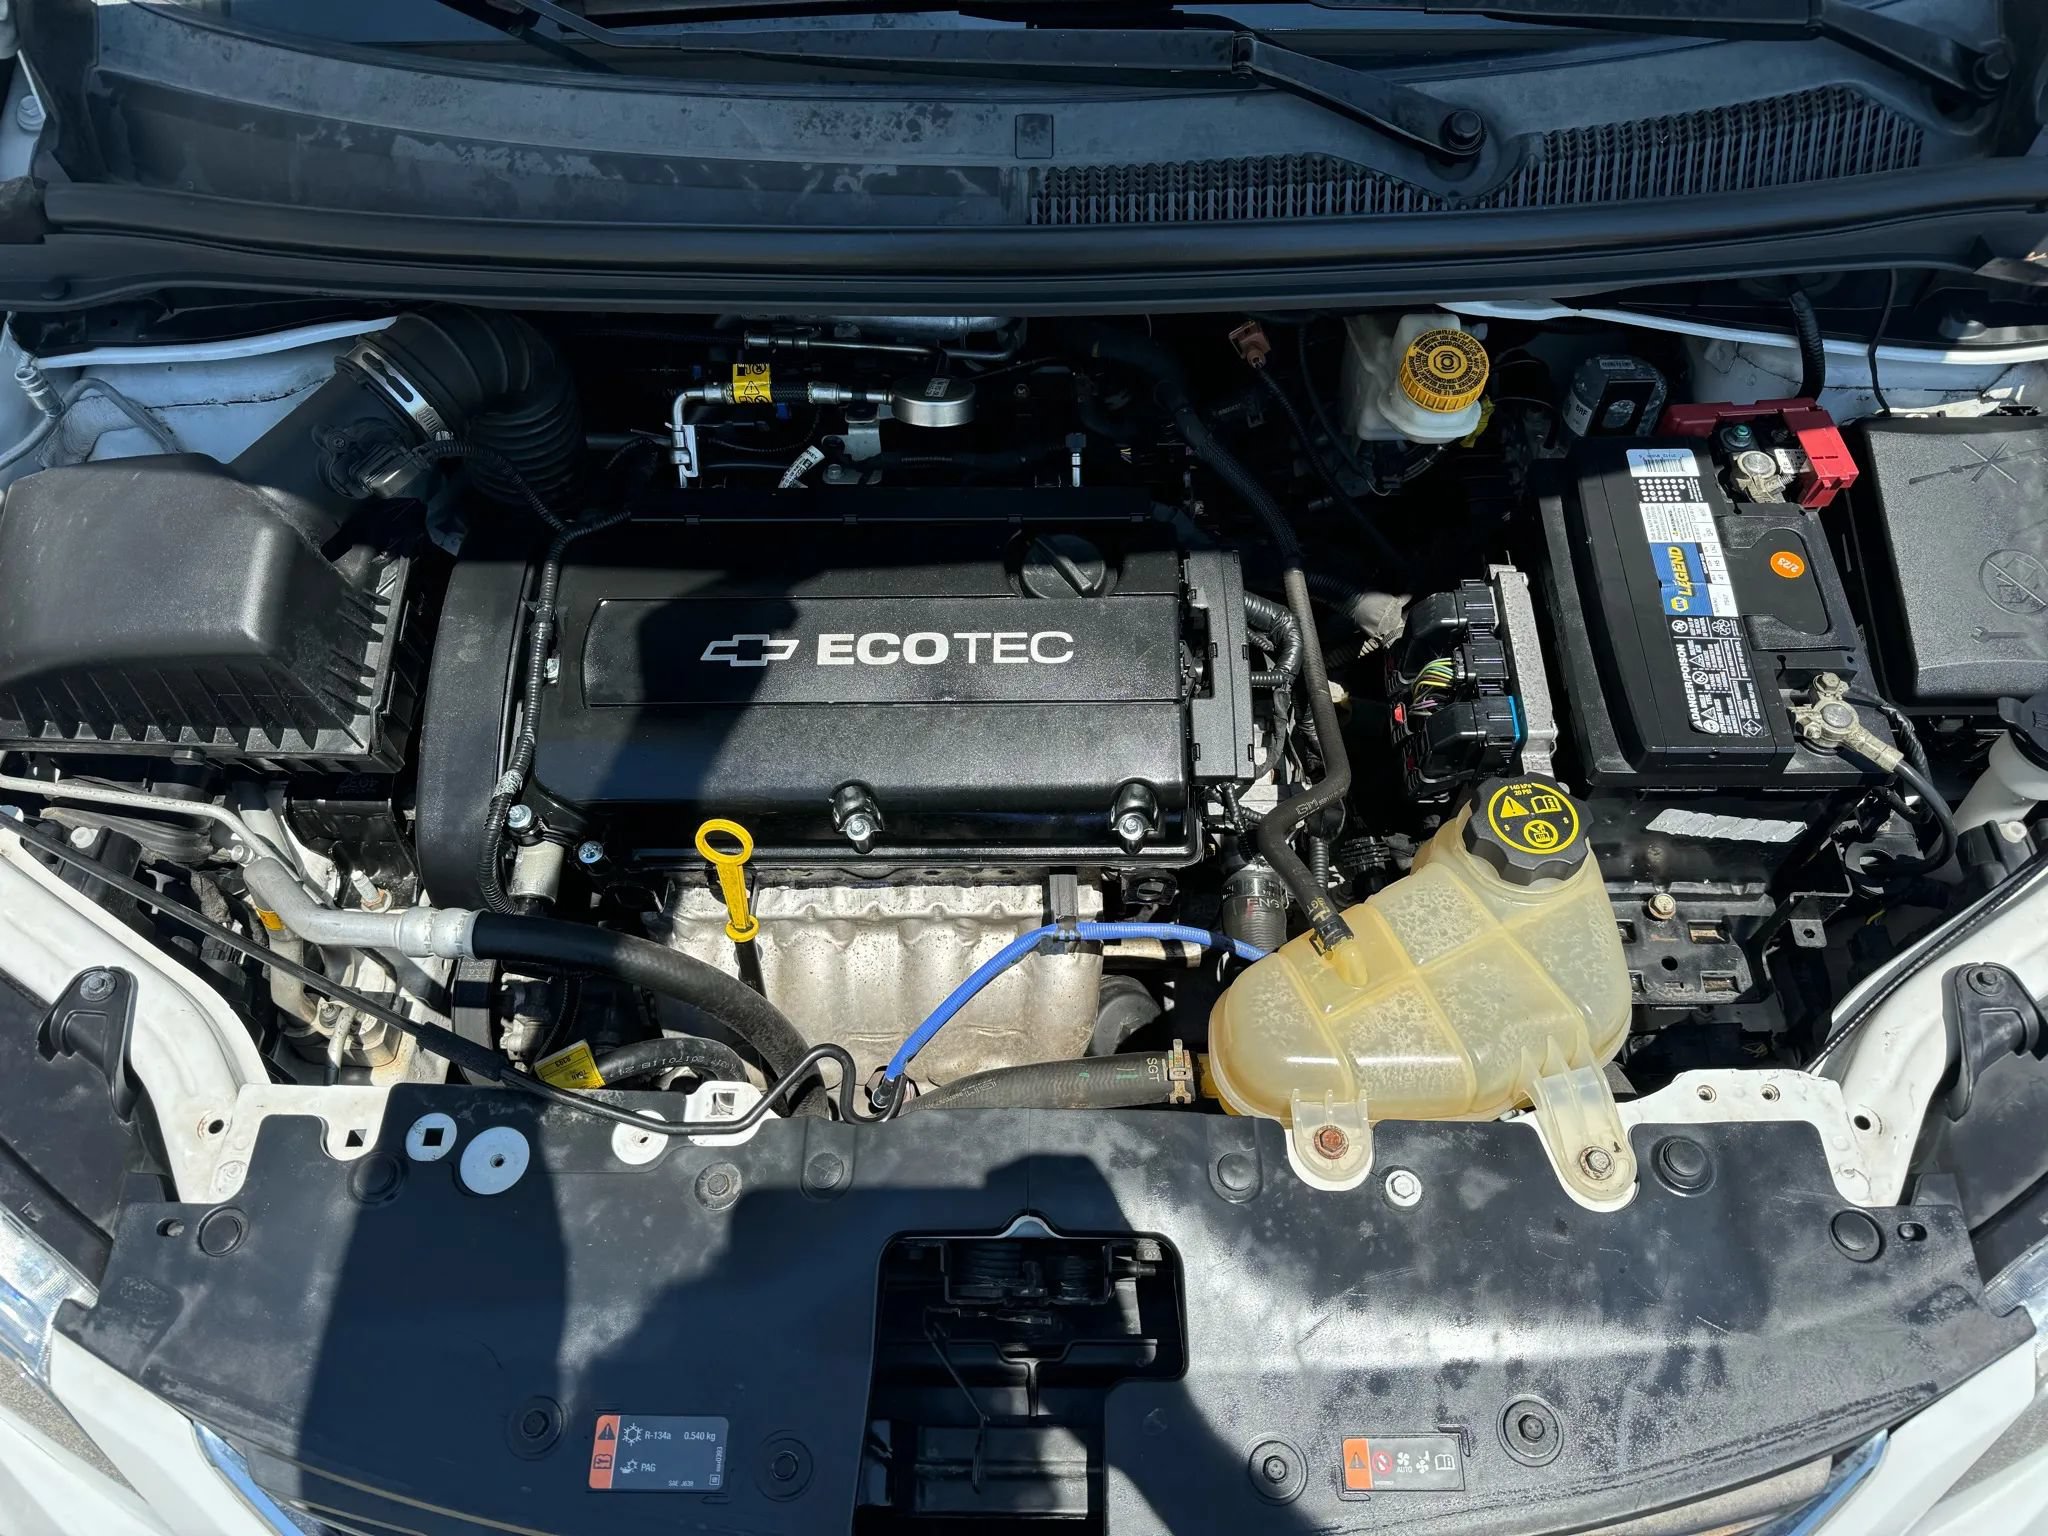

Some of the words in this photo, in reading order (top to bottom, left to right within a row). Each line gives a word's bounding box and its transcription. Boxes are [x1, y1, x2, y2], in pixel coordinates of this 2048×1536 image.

[1667, 546, 1692, 596] LEGEND
[817, 631, 1073, 665] ECOTEC
[1675, 643, 1701, 720] DANGER/POISON
[1306, 896, 1325, 914] SGT
[1145, 1057, 1160, 1082] SGT
[644, 1432, 671, 1440] R-134a
[684, 1431, 705, 1440] 0.540
[706, 1431, 716, 1442] kg
[641, 1463, 656, 1472] PAG
